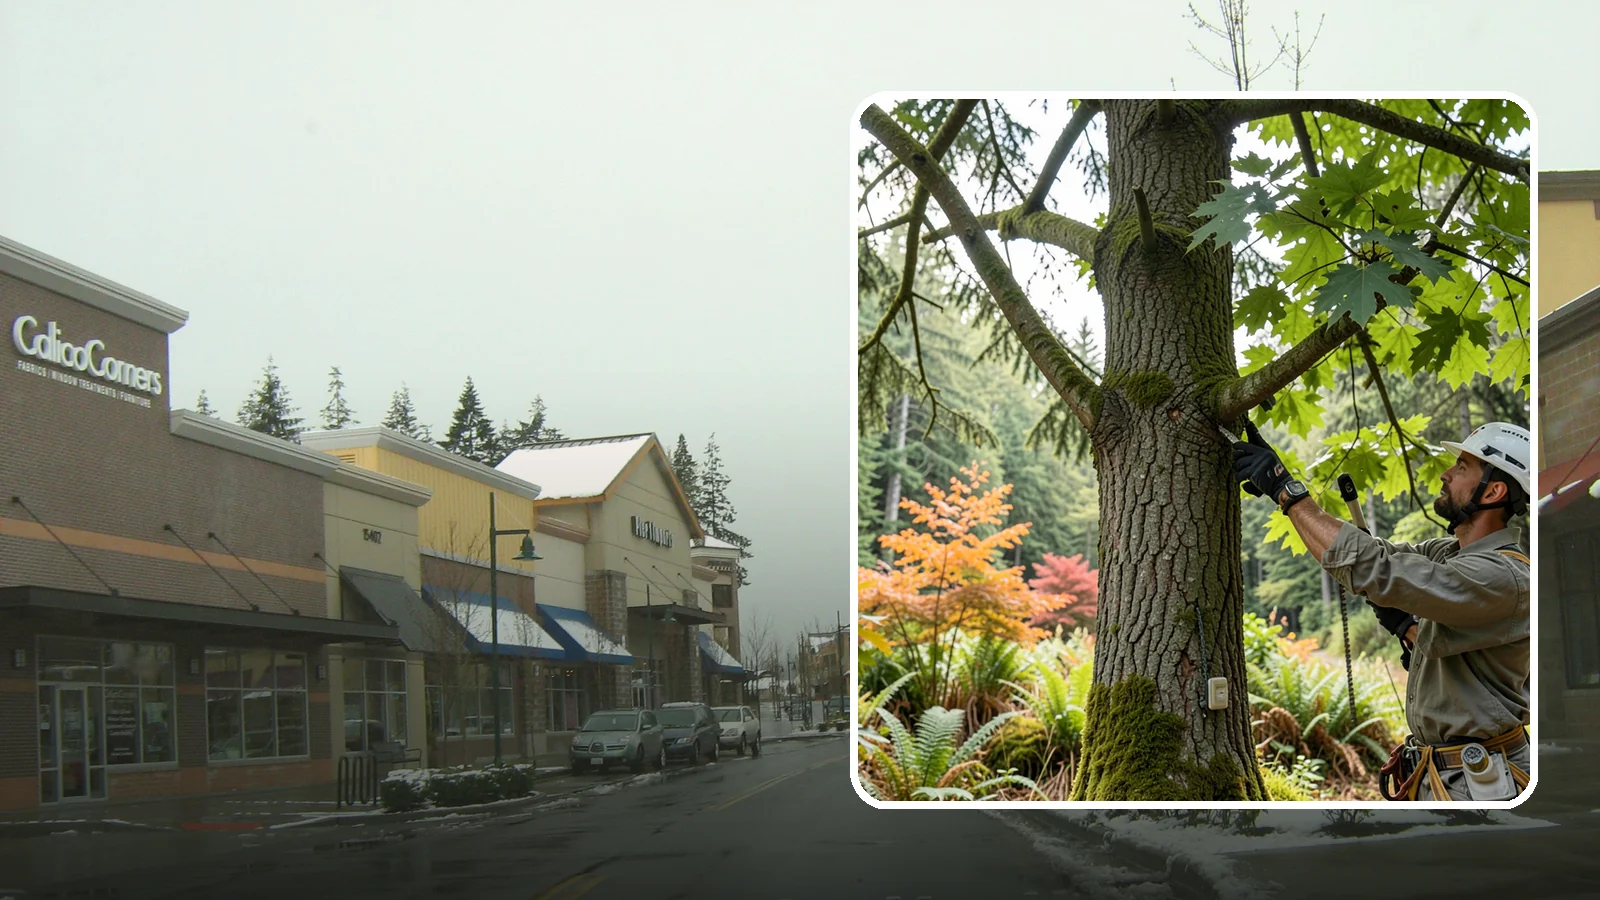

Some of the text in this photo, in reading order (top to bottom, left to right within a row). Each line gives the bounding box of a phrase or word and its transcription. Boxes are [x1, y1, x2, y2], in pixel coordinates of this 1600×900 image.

[17, 360, 47, 378] FABRICS
[51, 370, 78, 387] WINDOW
[79, 378, 117, 399] TREATMENTS
